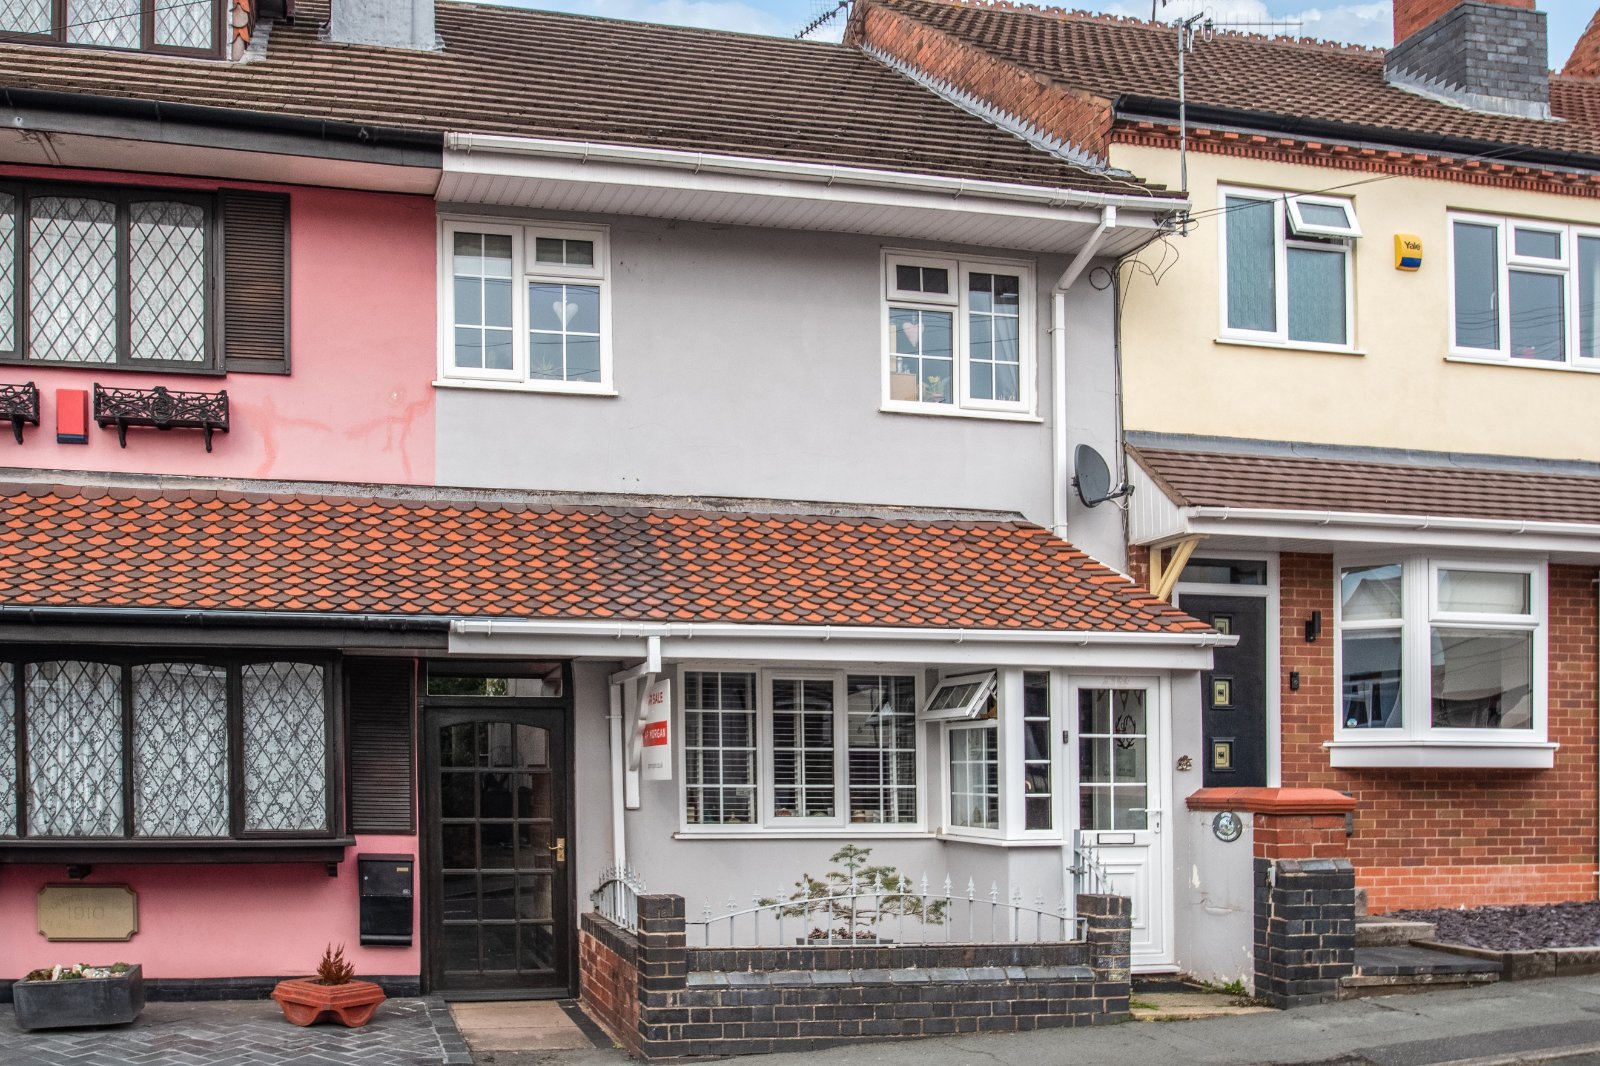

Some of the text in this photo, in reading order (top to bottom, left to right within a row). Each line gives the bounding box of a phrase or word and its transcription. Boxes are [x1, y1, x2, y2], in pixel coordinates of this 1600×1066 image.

[1404, 241, 1421, 250] Yale
[653, 692, 663, 704] SALE
[650, 728, 665, 738] MORGAN
